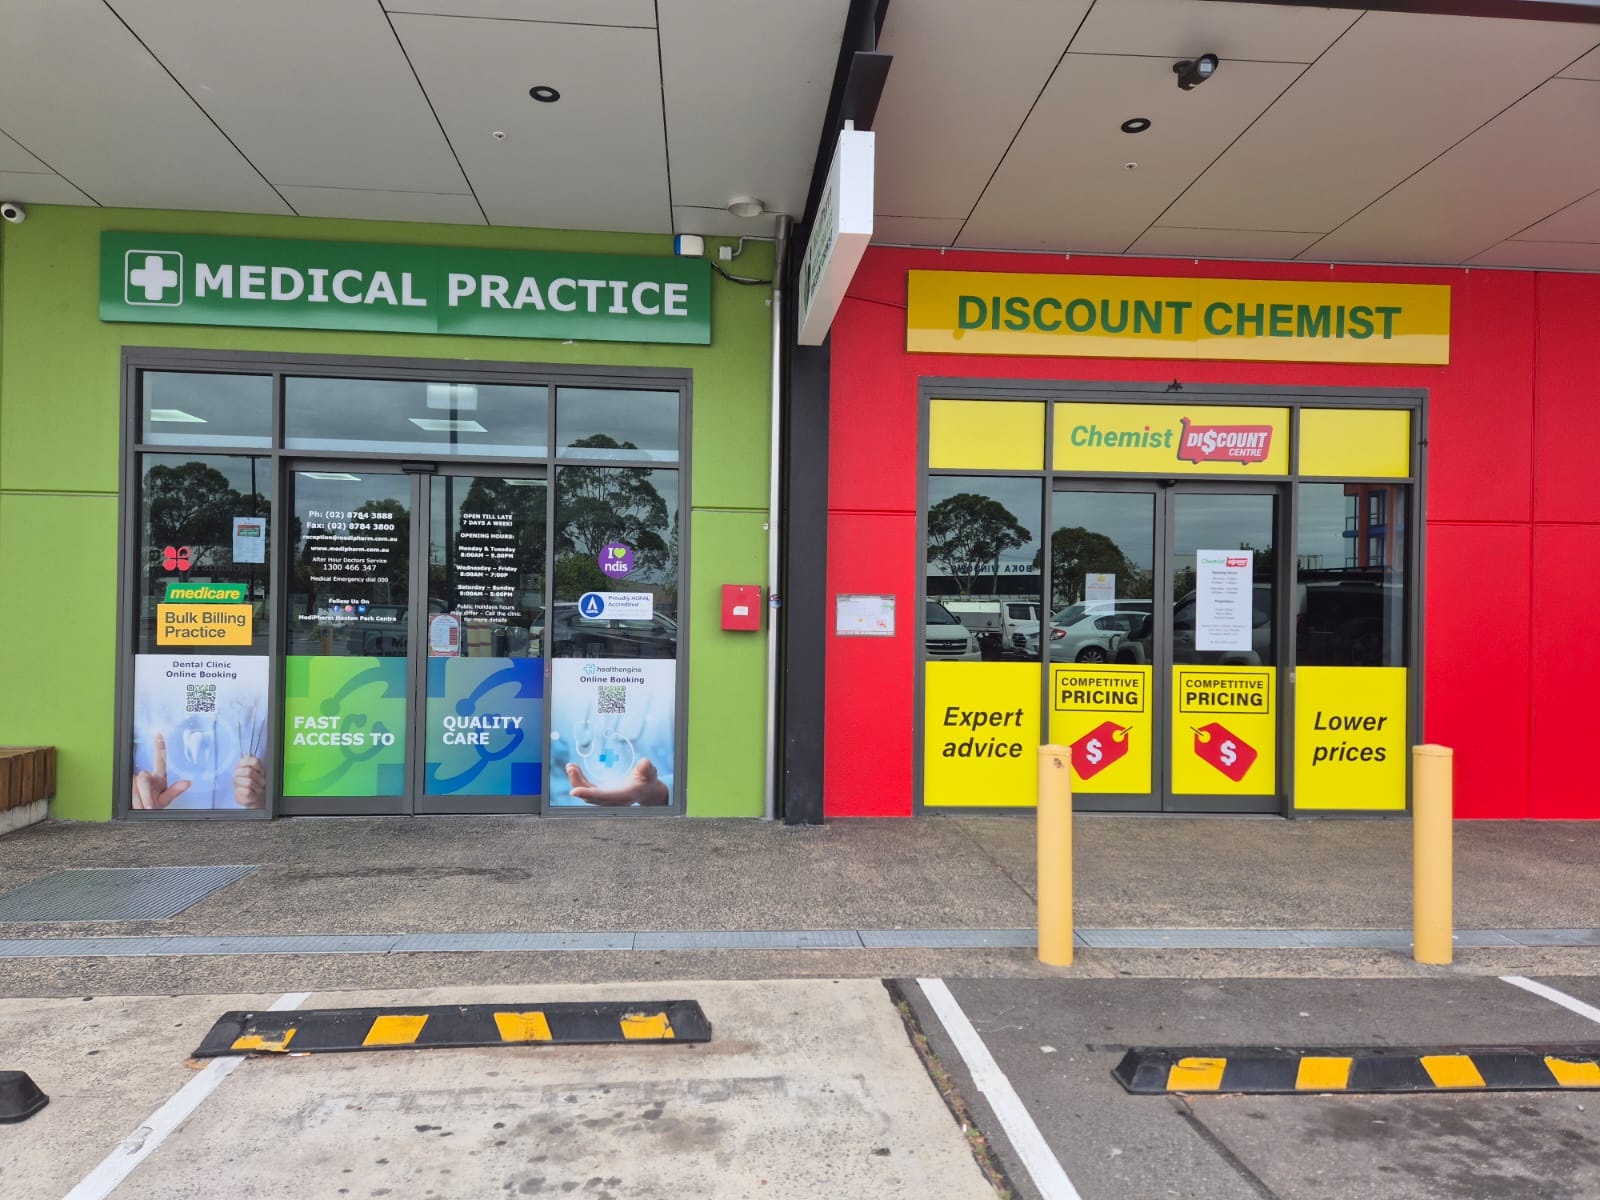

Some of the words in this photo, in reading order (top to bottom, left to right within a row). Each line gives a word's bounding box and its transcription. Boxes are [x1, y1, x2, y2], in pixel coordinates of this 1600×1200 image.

[194, 263, 427, 307] MEDICAL
[447, 272, 689, 317] PRACTICE
[958, 295, 1192, 335] DISCOUNT
[1203, 302, 1402, 340] CHEMIST
[1071, 424, 1174, 449] Chemist
[1229, 448, 1263, 457] CENTRE
[309, 510, 322, 518] Ph:
[325, 511, 344, 519] (02)
[347, 512, 369, 520] 8784
[371, 512, 393, 520] 3888
[328, 522, 346, 530] (02)
[608, 548, 614, 559] I
[605, 561, 628, 572] ndis
[170, 587, 240, 600] medicare
[165, 612, 198, 624] Bulk
[202, 611, 246, 626] Billing
[165, 626, 226, 638] Practice
[200, 671, 237, 679] Booking
[597, 666, 642, 674] healthengine
[610, 676, 645, 684] Booking
[1061, 677, 1139, 688] COMPETITIVE
[1186, 679, 1264, 689] COMPETITIVE
[1061, 690, 1139, 705] PRICING
[1186, 692, 1263, 706] PRICING
[293, 716, 341, 729] FAST
[443, 716, 523, 730] QUALITY
[943, 706, 1024, 731] Expert
[1314, 711, 1387, 732] Lower
[293, 732, 365, 746] ACCESS
[370, 732, 395, 746] TO
[443, 732, 490, 745] CARE
[942, 737, 1023, 758] advice
[1312, 741, 1387, 766] prices
